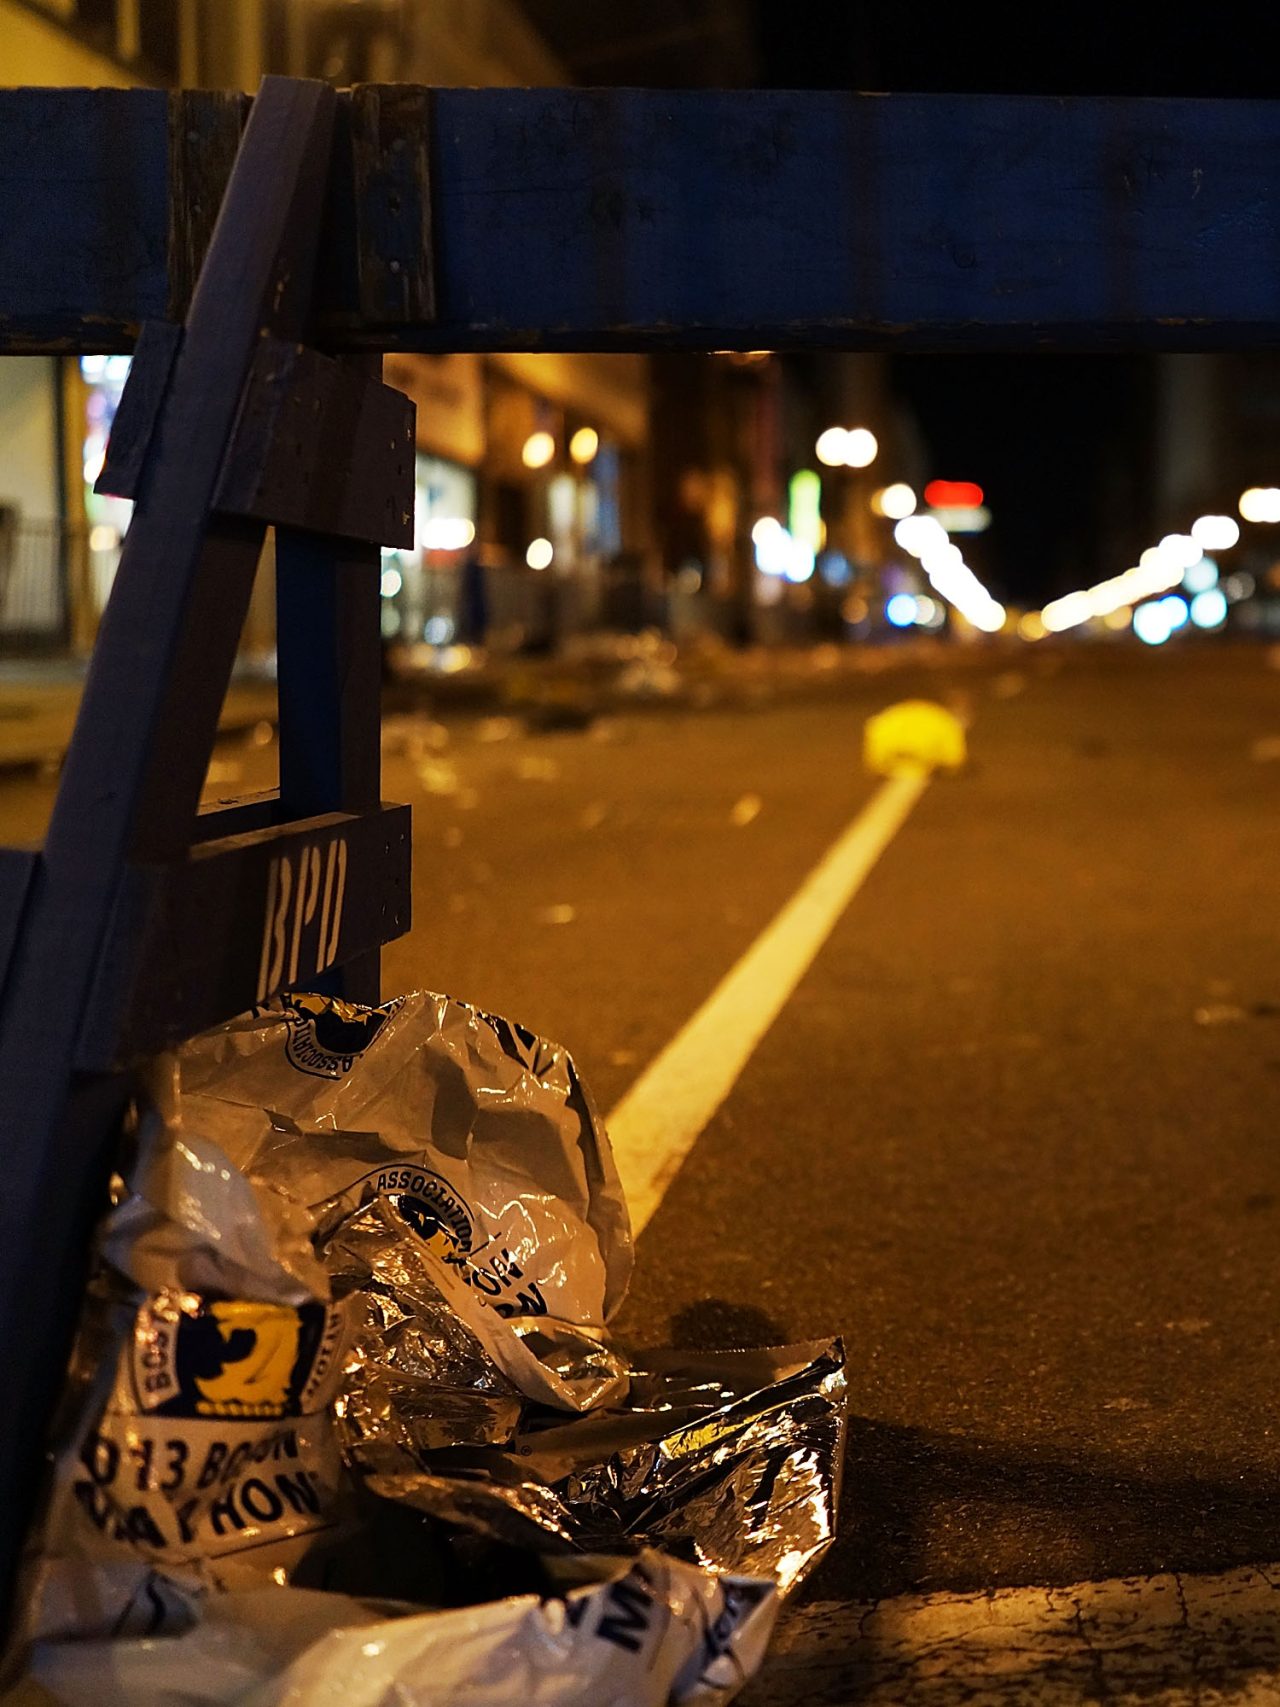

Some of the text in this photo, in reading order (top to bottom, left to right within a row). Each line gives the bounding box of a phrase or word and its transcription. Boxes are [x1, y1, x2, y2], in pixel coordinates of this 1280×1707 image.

[256, 838, 347, 1003] BPD
[376, 1171, 473, 1253] ASSOCIATION
[80, 1436, 189, 1492] 013
